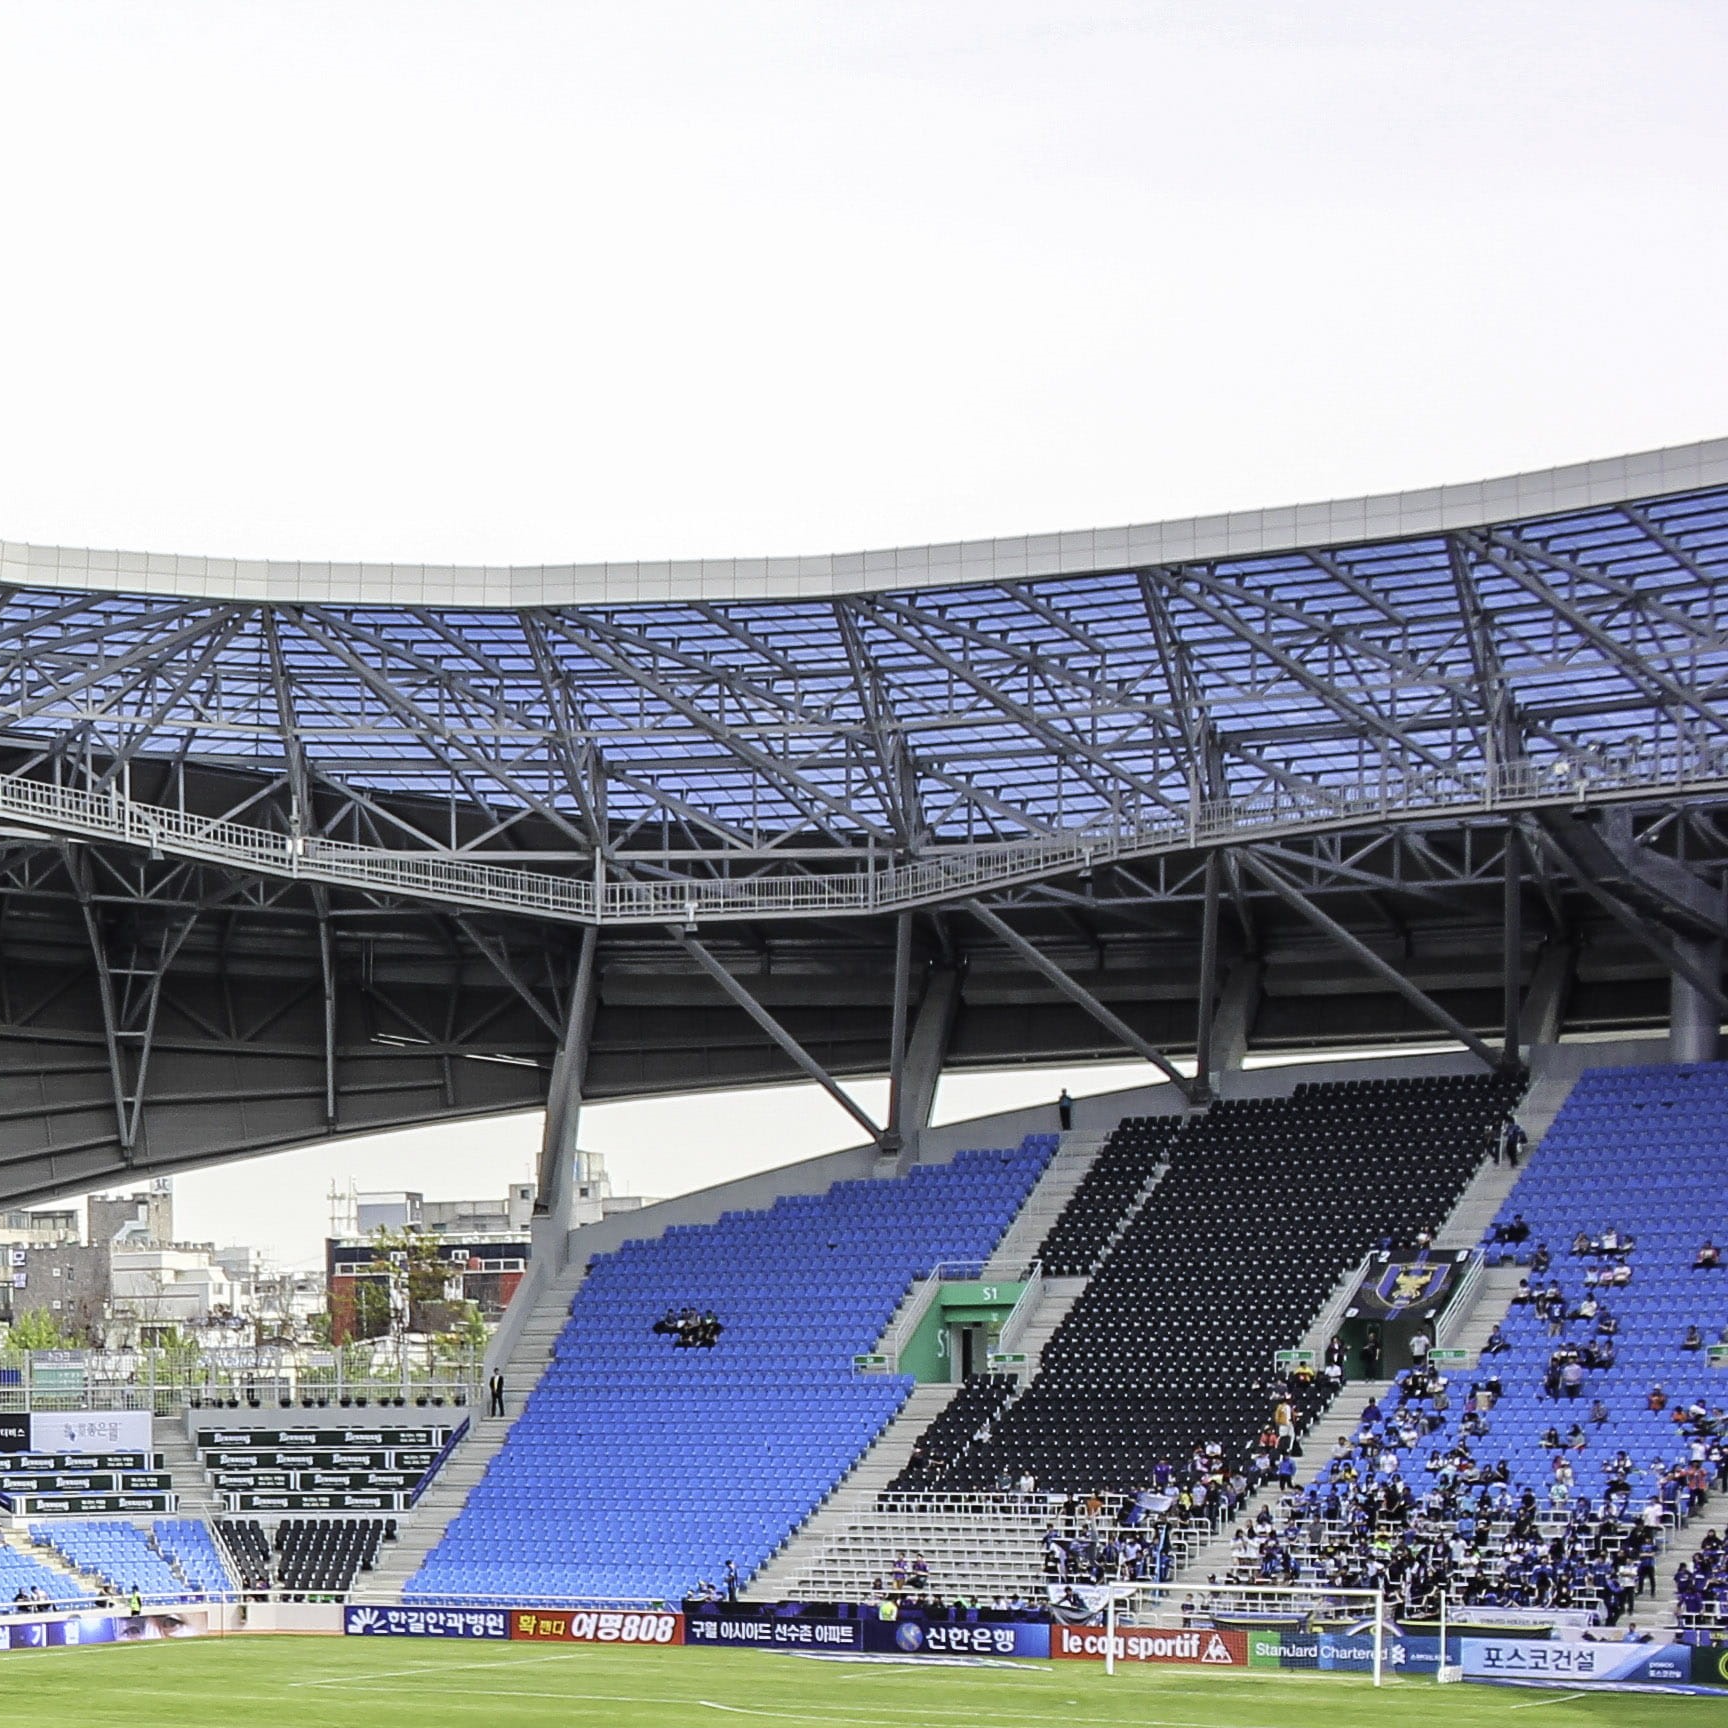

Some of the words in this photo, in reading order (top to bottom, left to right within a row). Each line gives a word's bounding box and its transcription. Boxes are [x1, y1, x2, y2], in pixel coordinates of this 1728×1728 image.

[983, 1287, 998, 1300] S1
[31, 1623, 47, 1647] 기
[387, 1611, 505, 1636] 한길안과병원
[518, 1614, 537, 1636] 확
[571, 1612, 676, 1642] 여명808
[692, 1620, 717, 1640] 구월
[720, 1622, 772, 1641] 아시아드
[774, 1624, 812, 1642] 선수촌
[815, 1625, 854, 1643] 아파트
[925, 1627, 1016, 1652] 신한은행
[1062, 1628, 1082, 1653] le
[1127, 1633, 1201, 1660] sportif
[1255, 1642, 1318, 1658] Standard
[1483, 1647, 1595, 1672] 포스코건설
